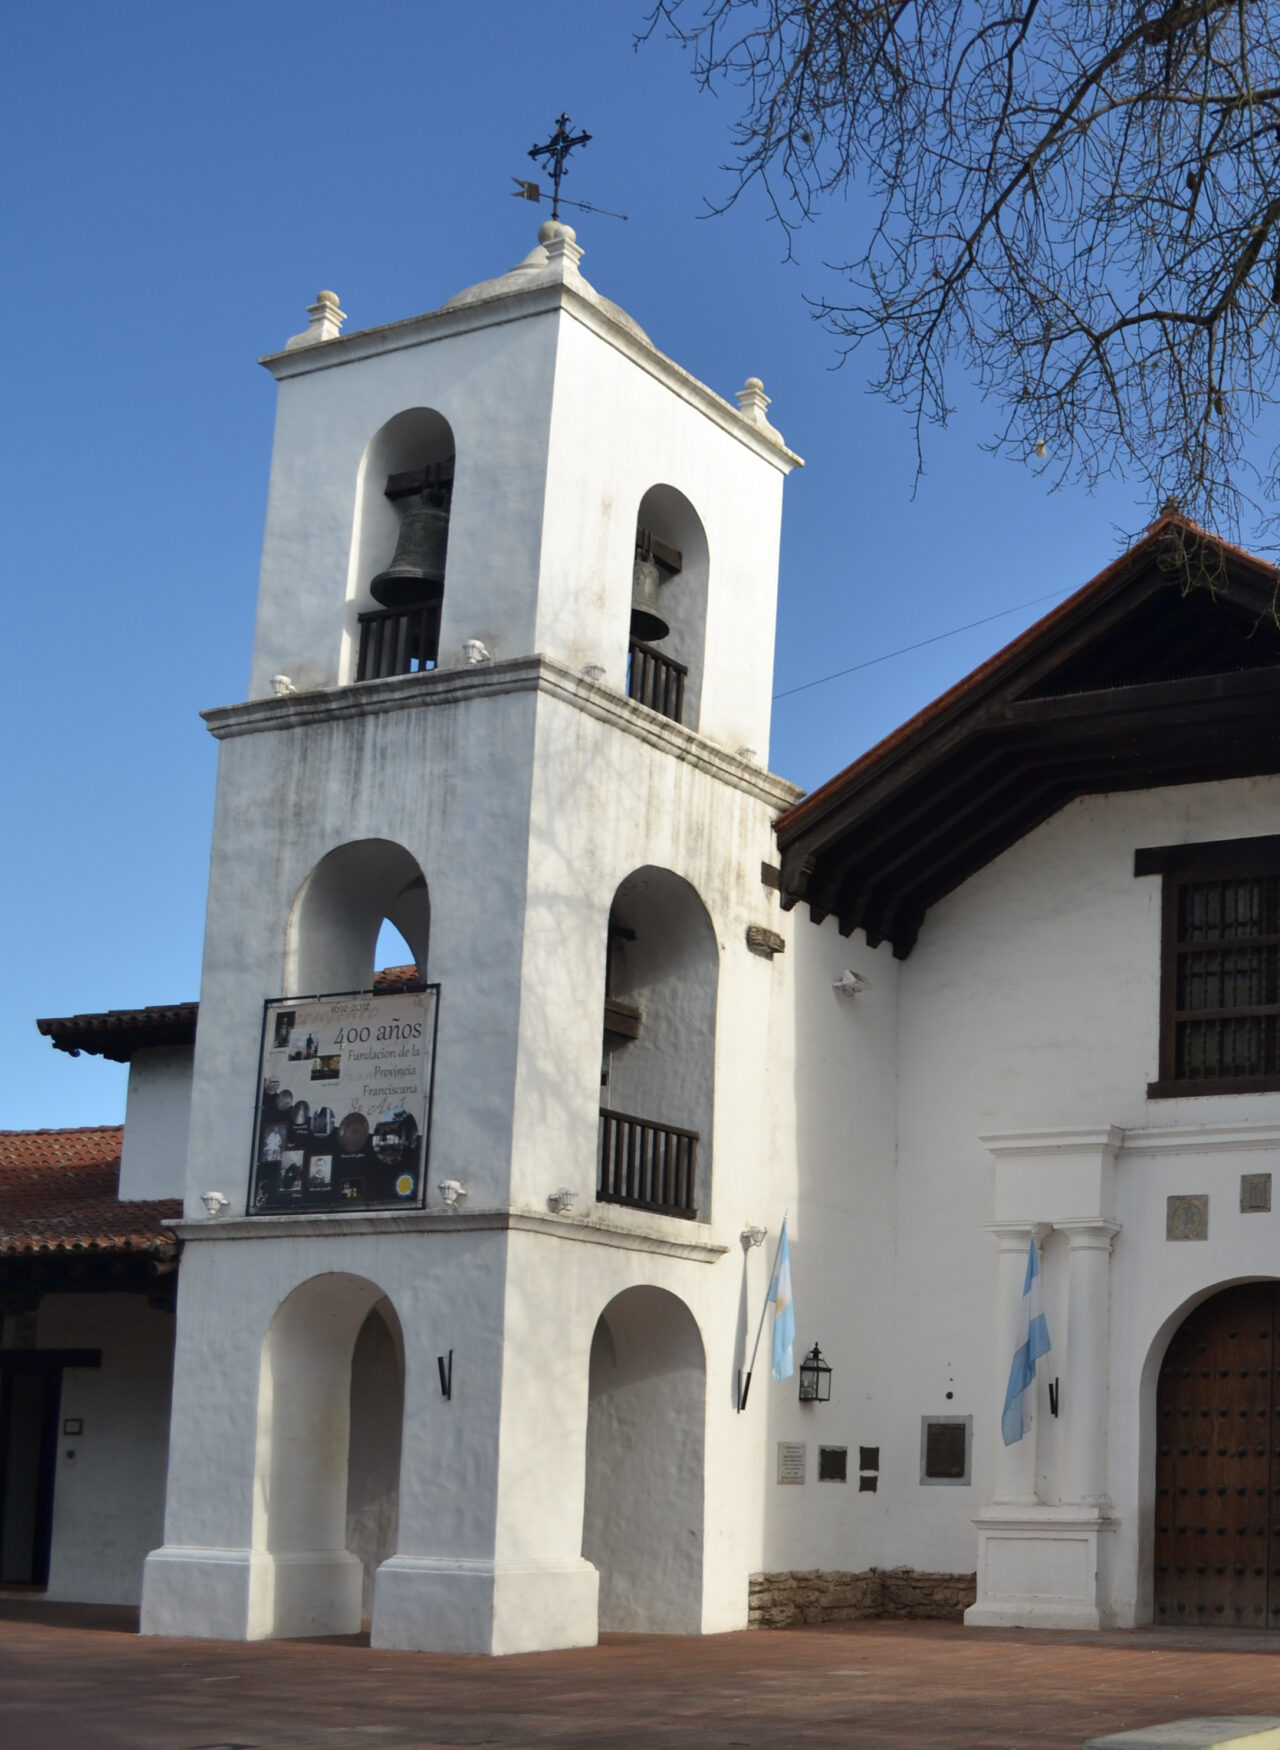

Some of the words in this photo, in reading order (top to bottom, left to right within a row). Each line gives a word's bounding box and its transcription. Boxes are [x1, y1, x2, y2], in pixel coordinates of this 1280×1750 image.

[333, 1026, 371, 1050] 400
[376, 1017, 422, 1041] años
[398, 1044, 410, 1058] de
[411, 1043, 421, 1057] la
[374, 1064, 417, 1079] Provincia
[362, 1084, 418, 1096] Franciscana
